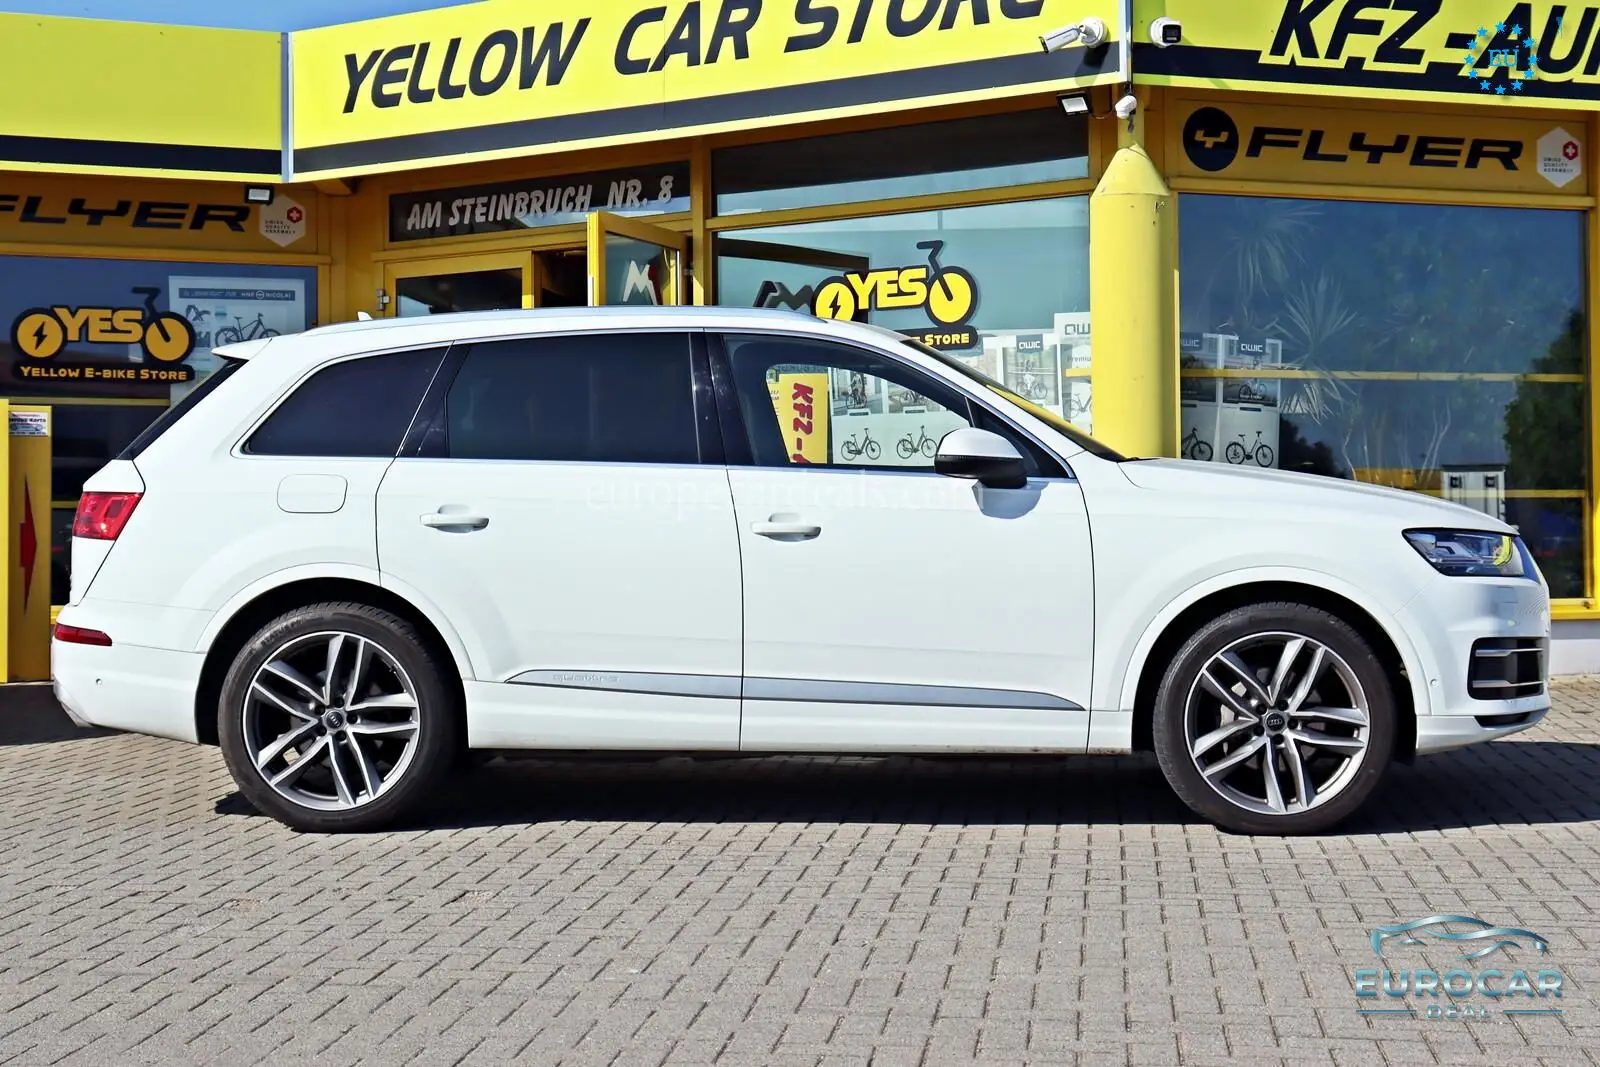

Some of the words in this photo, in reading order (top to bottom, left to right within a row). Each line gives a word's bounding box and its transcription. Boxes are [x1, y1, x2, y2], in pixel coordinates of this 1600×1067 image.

[342, 17, 592, 114] YELLOW
[614, 0, 762, 76] CAR
[784, 0, 1045, 53] STO
[1245, 126, 1524, 171] FLYER
[406, 203, 442, 232] AM
[448, 185, 593, 227] STEINBRUCH
[606, 179, 649, 209] NR.
[657, 175, 675, 204] 8
[846, 267, 928, 310] YES
[53, 307, 144, 342] YES
[925, 333, 970, 346] STORE
[20, 366, 80, 378] YELLOW
[85, 367, 136, 380] E-BIKE
[140, 369, 188, 381] STORE
